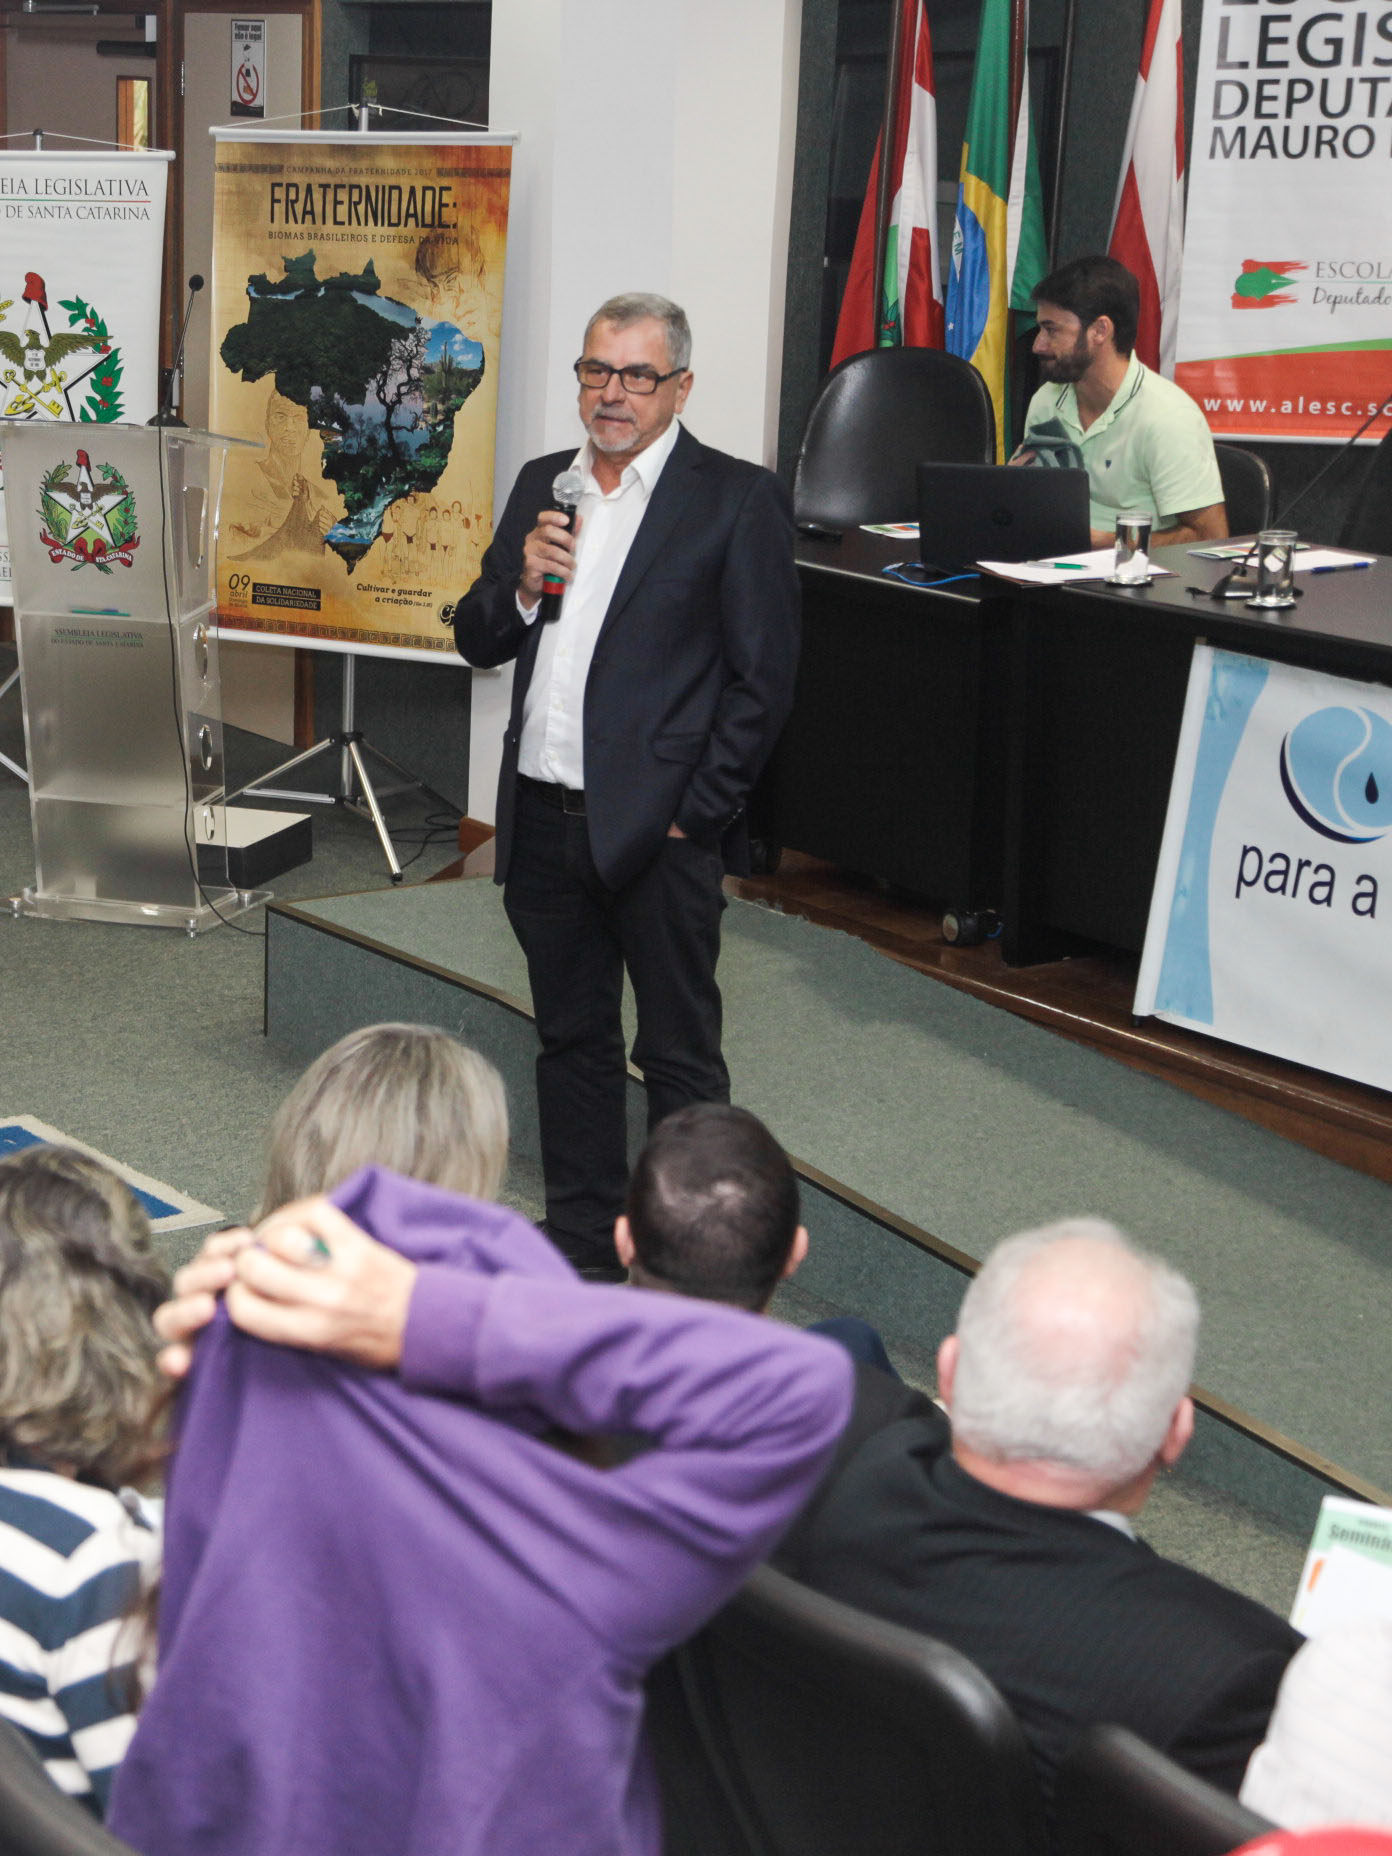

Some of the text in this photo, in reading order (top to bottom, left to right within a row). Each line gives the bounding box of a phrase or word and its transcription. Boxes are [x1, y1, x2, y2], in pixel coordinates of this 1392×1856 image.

[1212, 77, 1392, 120] DEPUT
[1209, 124, 1376, 160] MAURO
[286, 166, 432, 176] CAMPANHA DA FRATERNIDADE 2017
[35, 178, 149, 197] LEGISLATIVA
[270, 182, 457, 229] FRATERNIDADE:
[6, 205, 23, 219] DE
[27, 205, 72, 220] SANTA
[76, 206, 151, 221] CATARINA
[268, 231, 305, 241] BIOMAS
[308, 232, 368, 243] BRASILEIROS
[372, 234, 377, 243] E
[380, 234, 415, 244] DEFESA
[51, 548, 76, 559] ESTADO
[228, 573, 251, 591] 09
[230, 590, 248, 599] abril
[256, 585, 316, 598] COLETA NACIONAL
[356, 583, 390, 594] Cultivar
[398, 589, 432, 597] guardar
[266, 596, 318, 609] SOLIDARIEDADE
[382, 596, 413, 606] criação
[1235, 844, 1378, 919] para a
